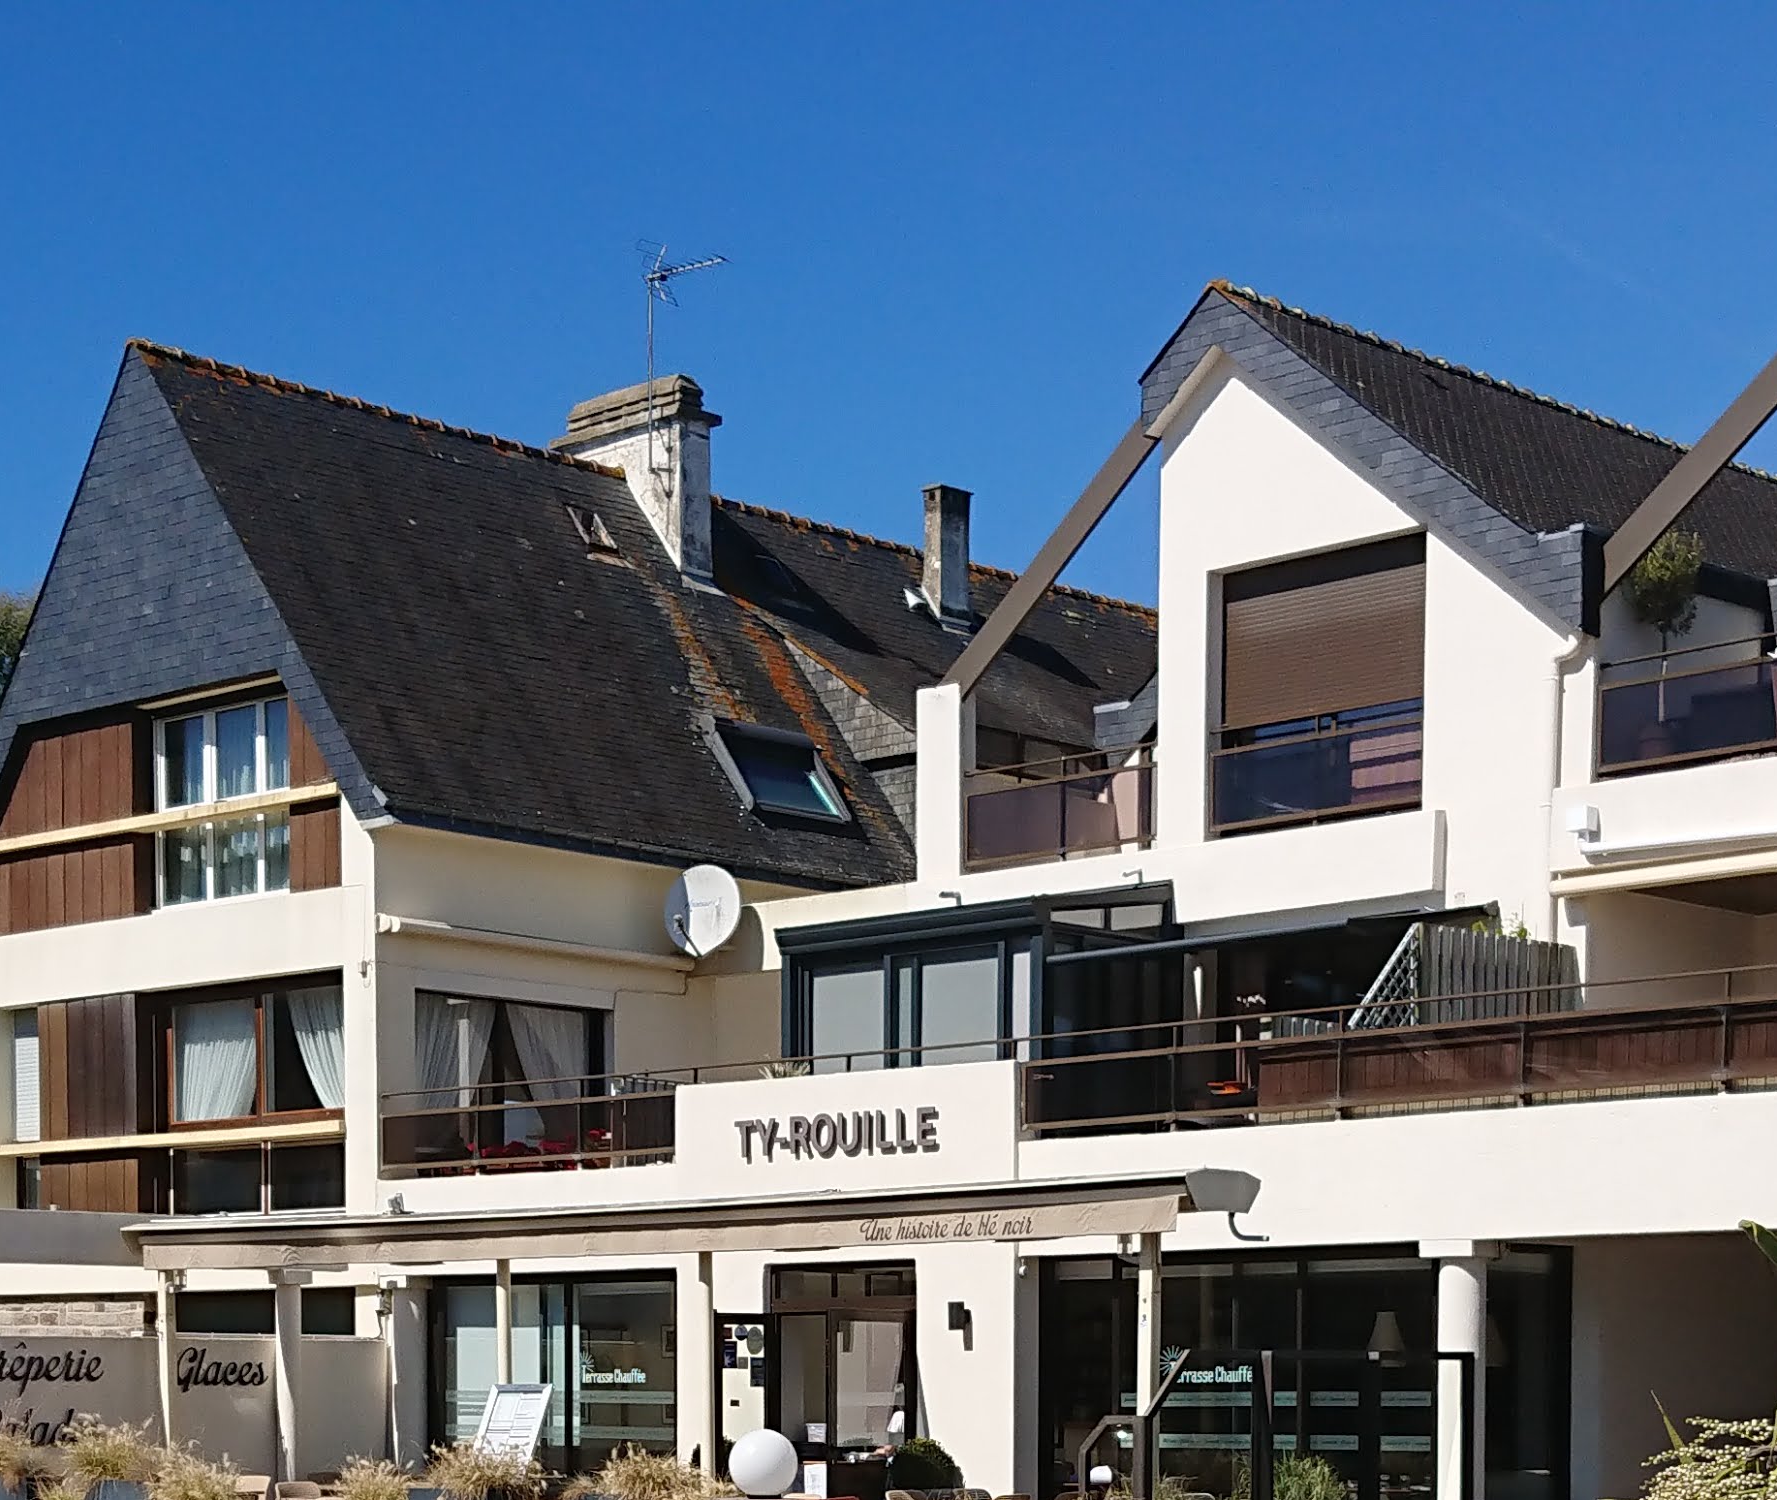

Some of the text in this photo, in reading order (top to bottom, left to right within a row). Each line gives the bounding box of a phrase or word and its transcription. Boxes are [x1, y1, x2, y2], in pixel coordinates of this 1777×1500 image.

[734, 1106, 940, 1164] TY-ROUILLE
[860, 1214, 1034, 1241] Une histoire de blé noir
[177, 1347, 269, 1392] Glaces
[581, 1365, 646, 1383] Terrasse Chauffée
[1215, 1365, 1253, 1383] Chauffé
